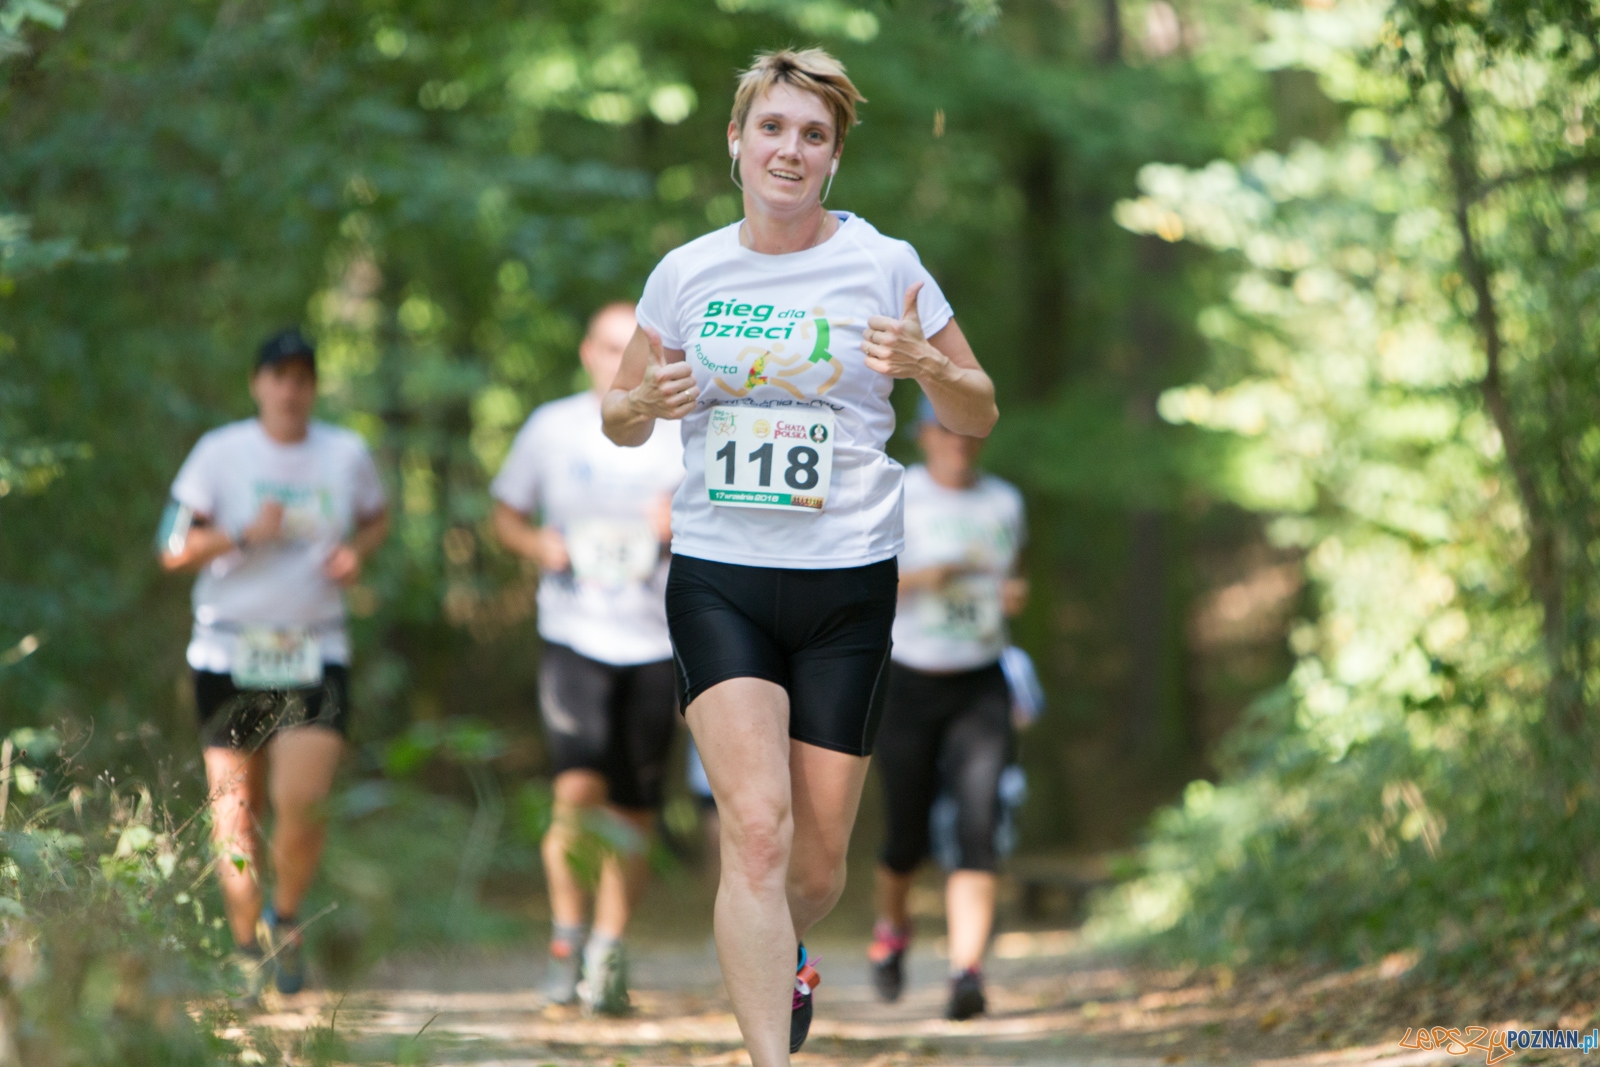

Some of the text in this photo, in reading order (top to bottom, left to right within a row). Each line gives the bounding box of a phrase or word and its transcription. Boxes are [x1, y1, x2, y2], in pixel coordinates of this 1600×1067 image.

[703, 299, 806, 322] Bieg dla
[700, 320, 795, 340] Dzieci
[694, 343, 738, 375] Roberta
[716, 440, 819, 490] 118
[715, 491, 725, 500] 17
